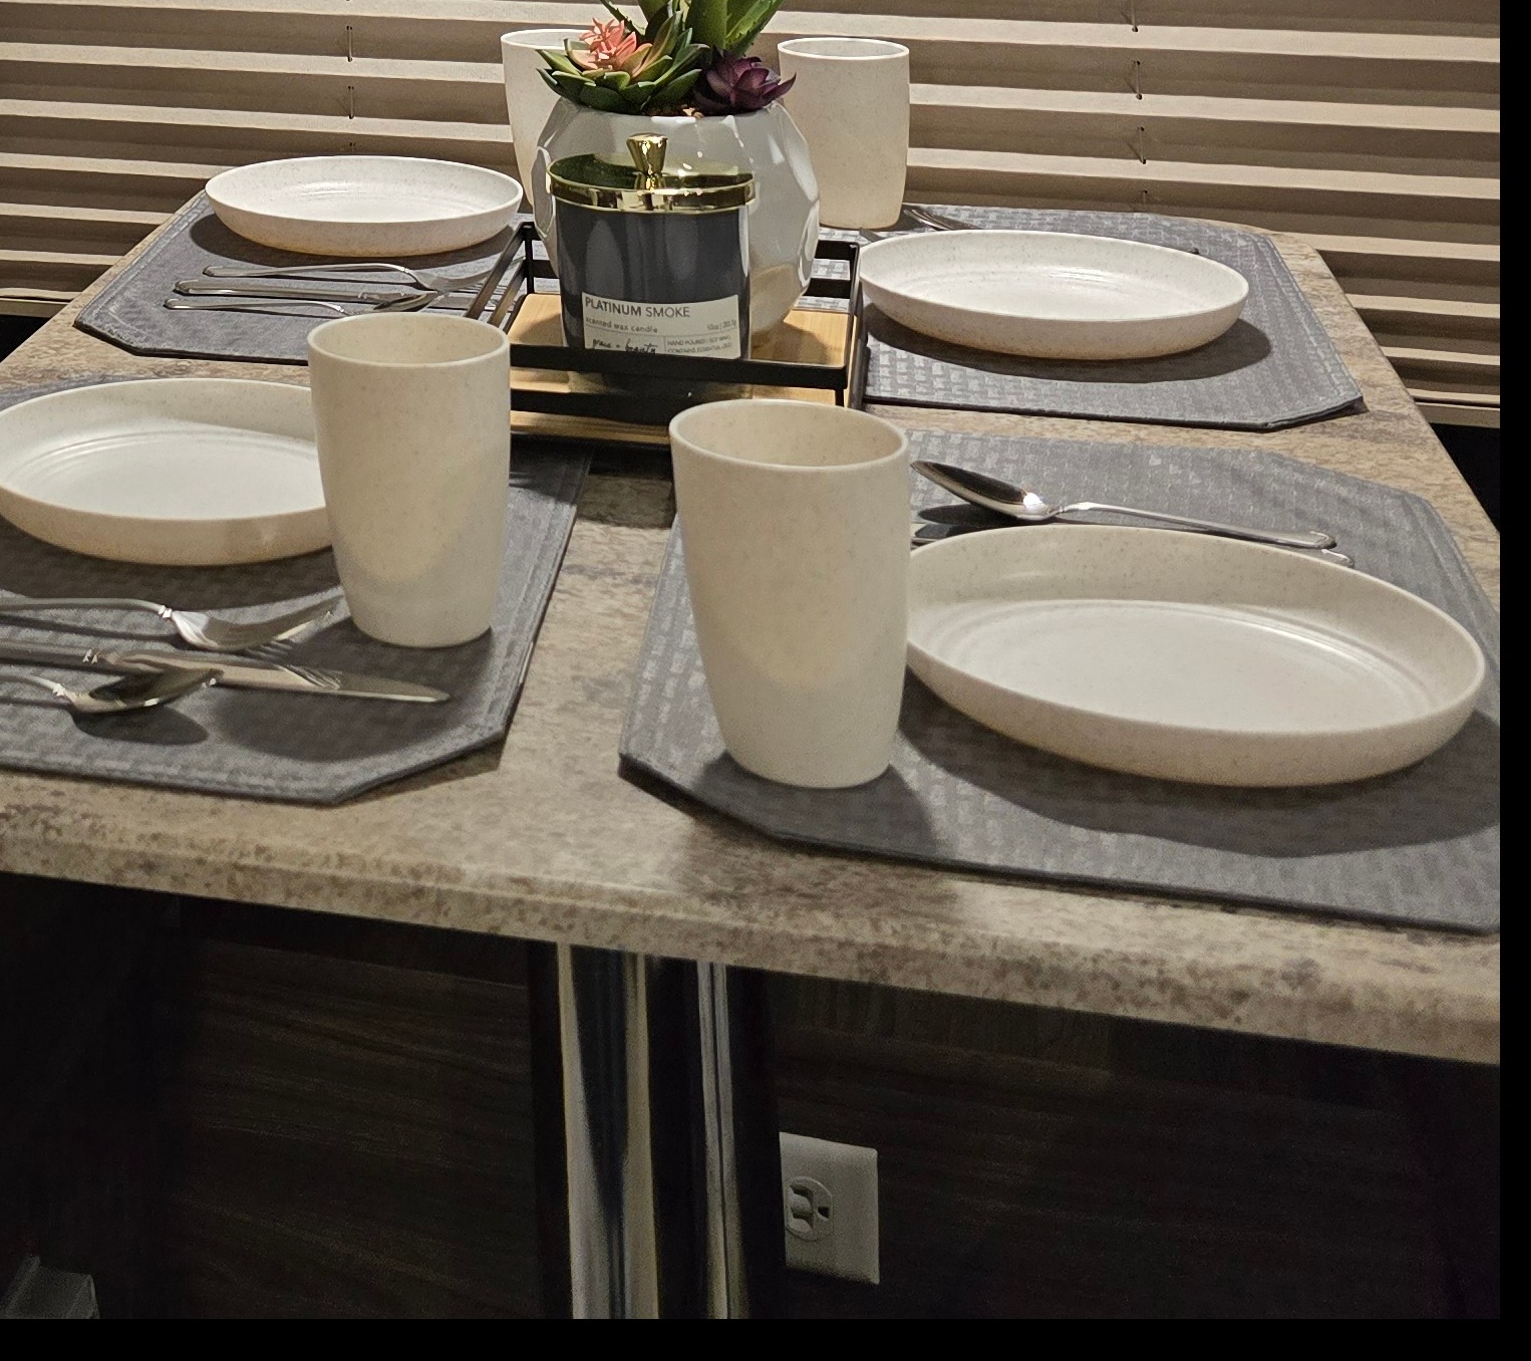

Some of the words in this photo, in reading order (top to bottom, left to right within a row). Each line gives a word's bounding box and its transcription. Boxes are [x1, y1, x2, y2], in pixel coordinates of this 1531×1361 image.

[585, 296, 642, 317] PLATINUM
[645, 306, 691, 318] SMOKE
[585, 316, 612, 328] scented
[613, 323, 629, 331] wax
[630, 325, 658, 333] candle
